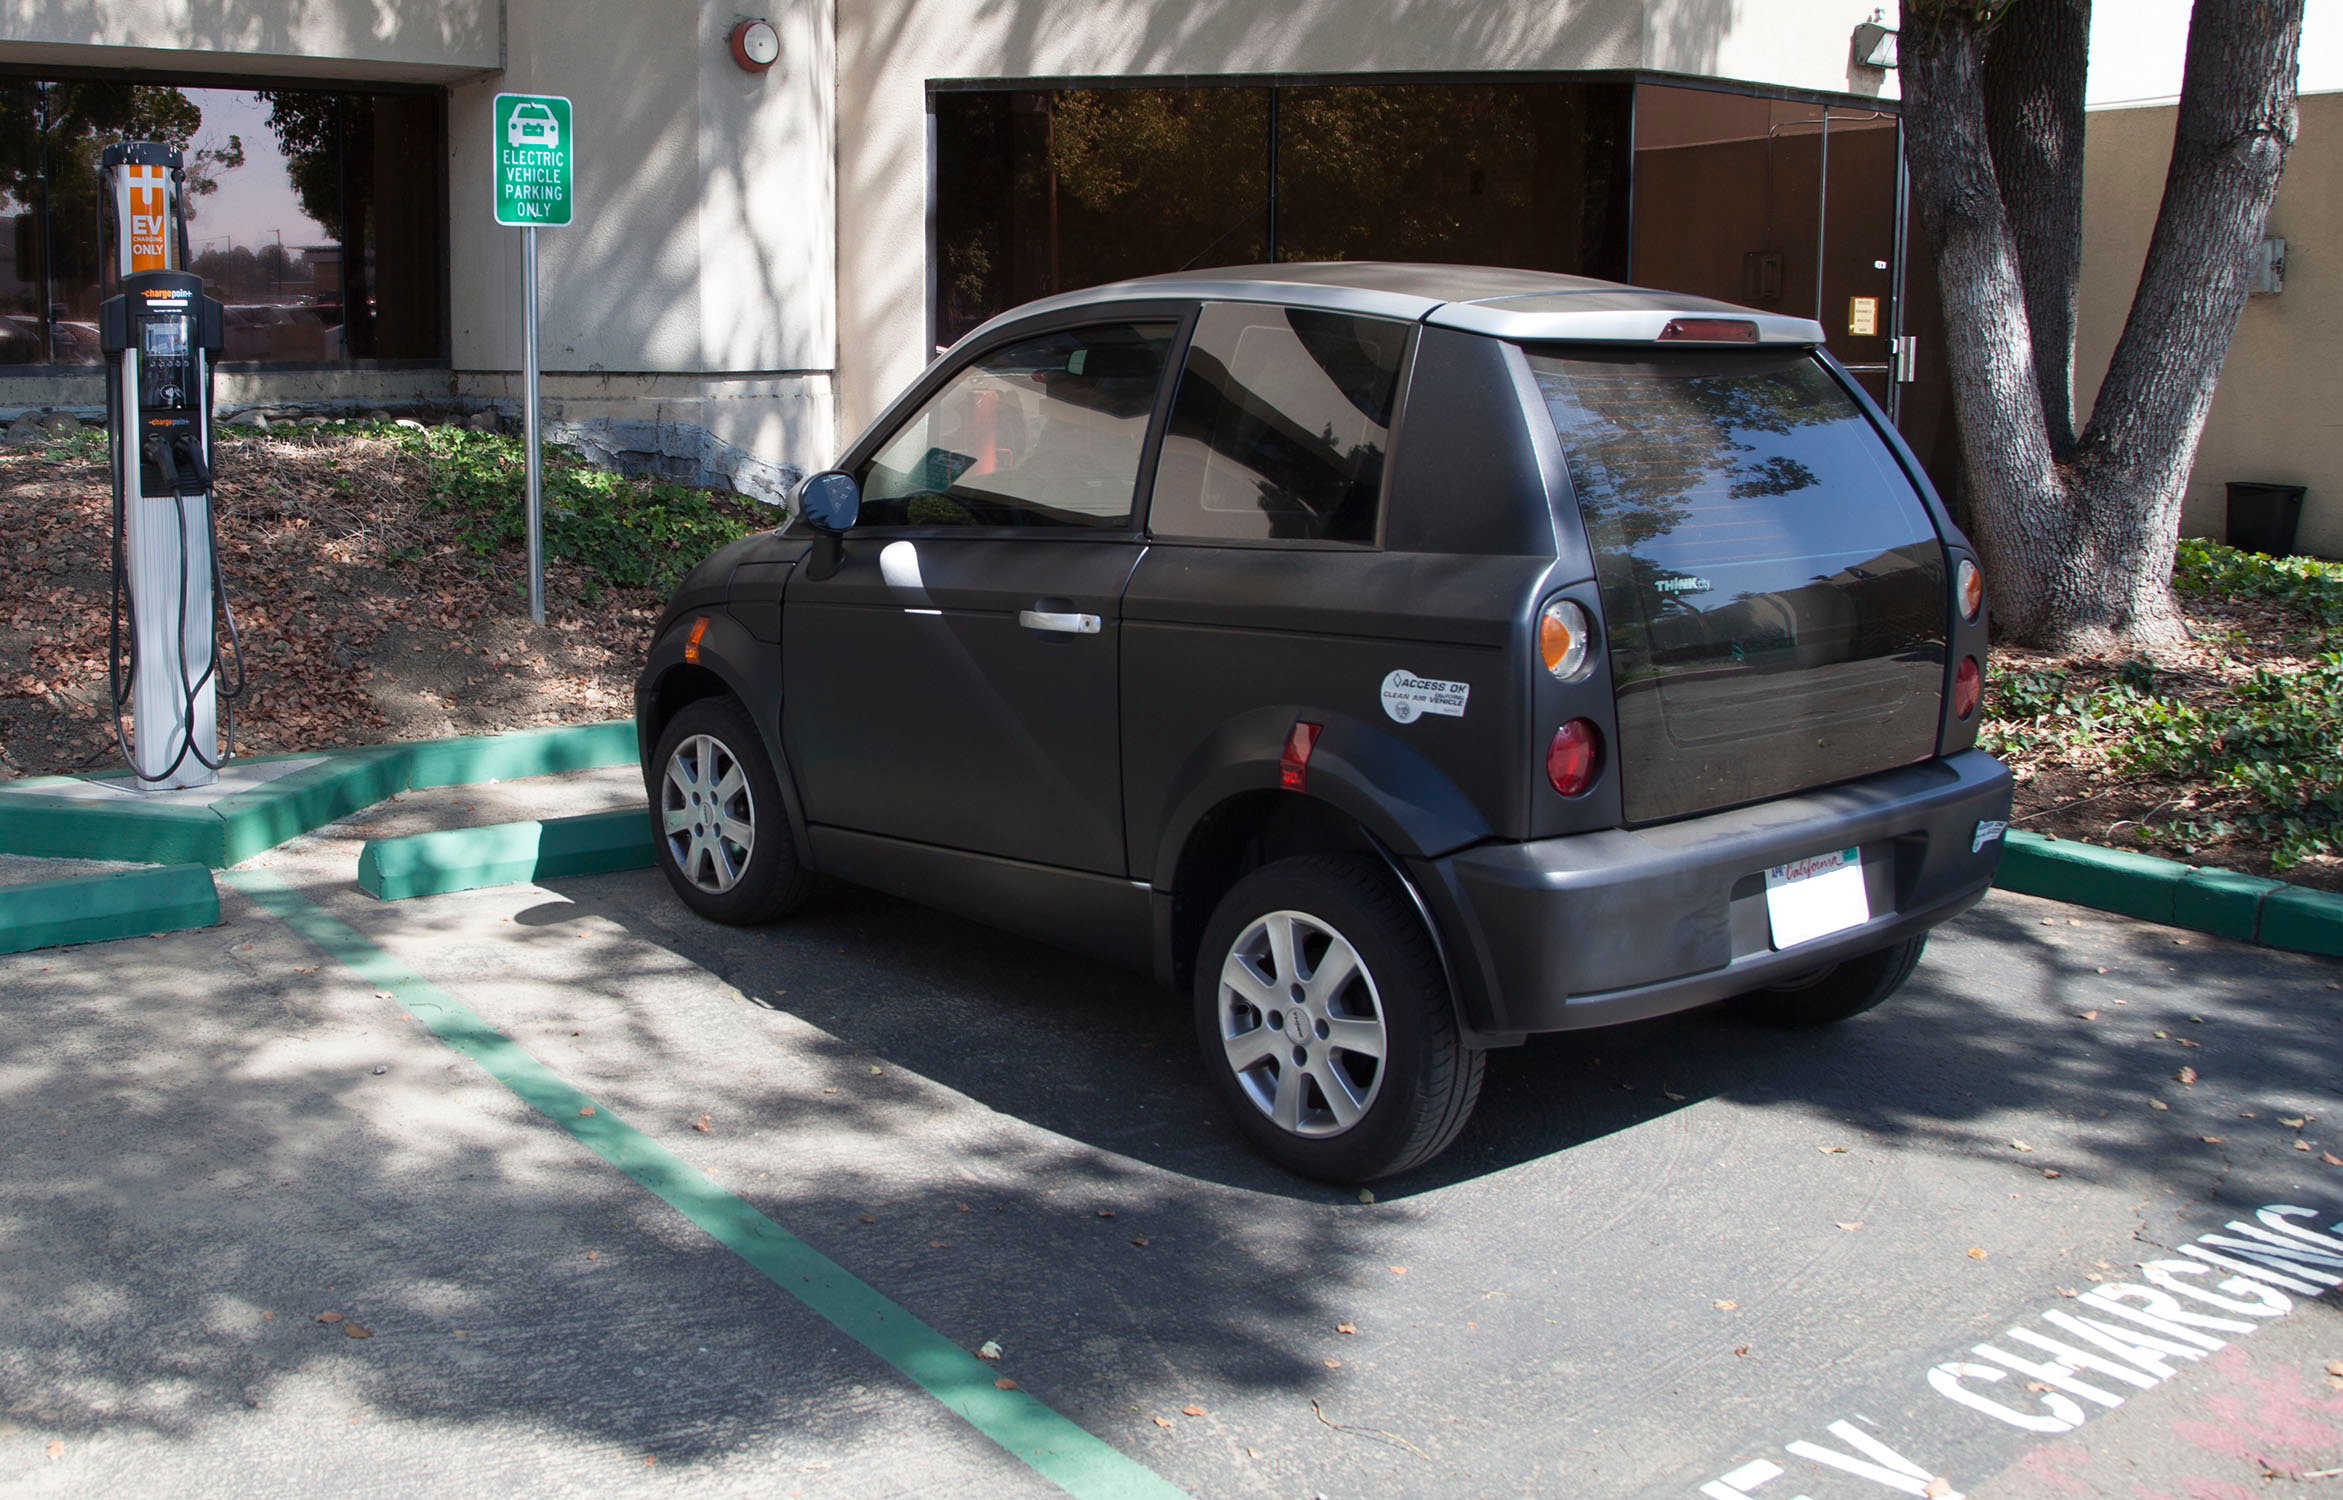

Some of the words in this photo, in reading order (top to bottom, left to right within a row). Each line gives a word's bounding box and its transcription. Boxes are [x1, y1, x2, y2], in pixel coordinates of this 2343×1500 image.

[503, 149, 564, 167] ELECTRIC
[506, 167, 561, 183] VEHICLE
[505, 184, 563, 201] PARKING
[517, 202, 551, 217] ONLY
[132, 215, 163, 235] EV
[133, 243, 164, 255] ONLY
[1401, 678, 1446, 692] ACCESS
[1450, 684, 1467, 694] OK
[1383, 690, 1410, 700] CLEAN
[1412, 694, 1427, 702] AIR
[1429, 696, 1463, 707] VEHICLE
[1786, 855, 1844, 881] California
